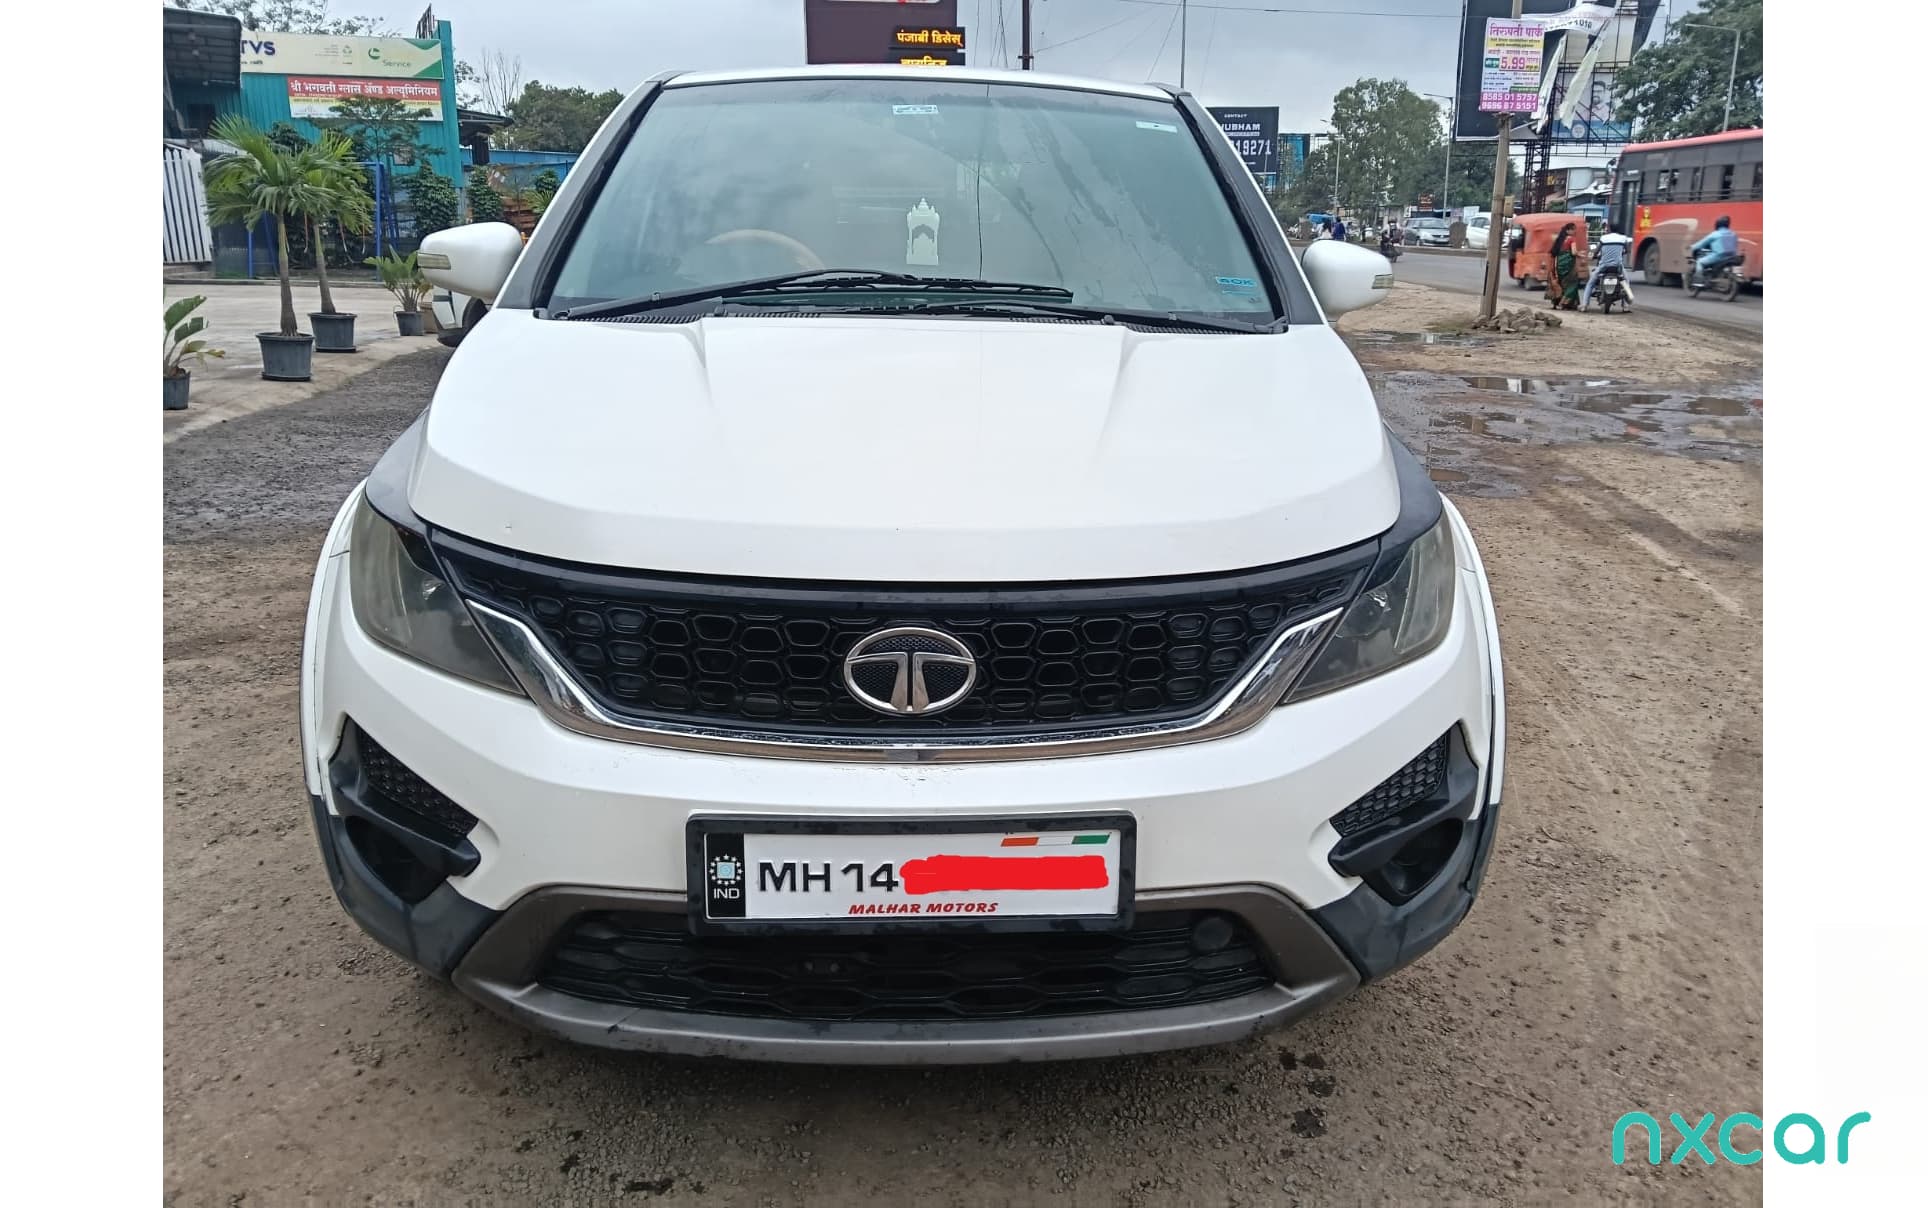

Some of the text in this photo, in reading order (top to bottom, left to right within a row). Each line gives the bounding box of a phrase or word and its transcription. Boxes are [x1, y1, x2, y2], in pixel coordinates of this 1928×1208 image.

[896, 29, 928, 43] पंजाबी
[1501, 57, 1525, 70] 5.99
[713, 887, 740, 899] IND
[848, 901, 999, 915] MALHAR MOTORS
